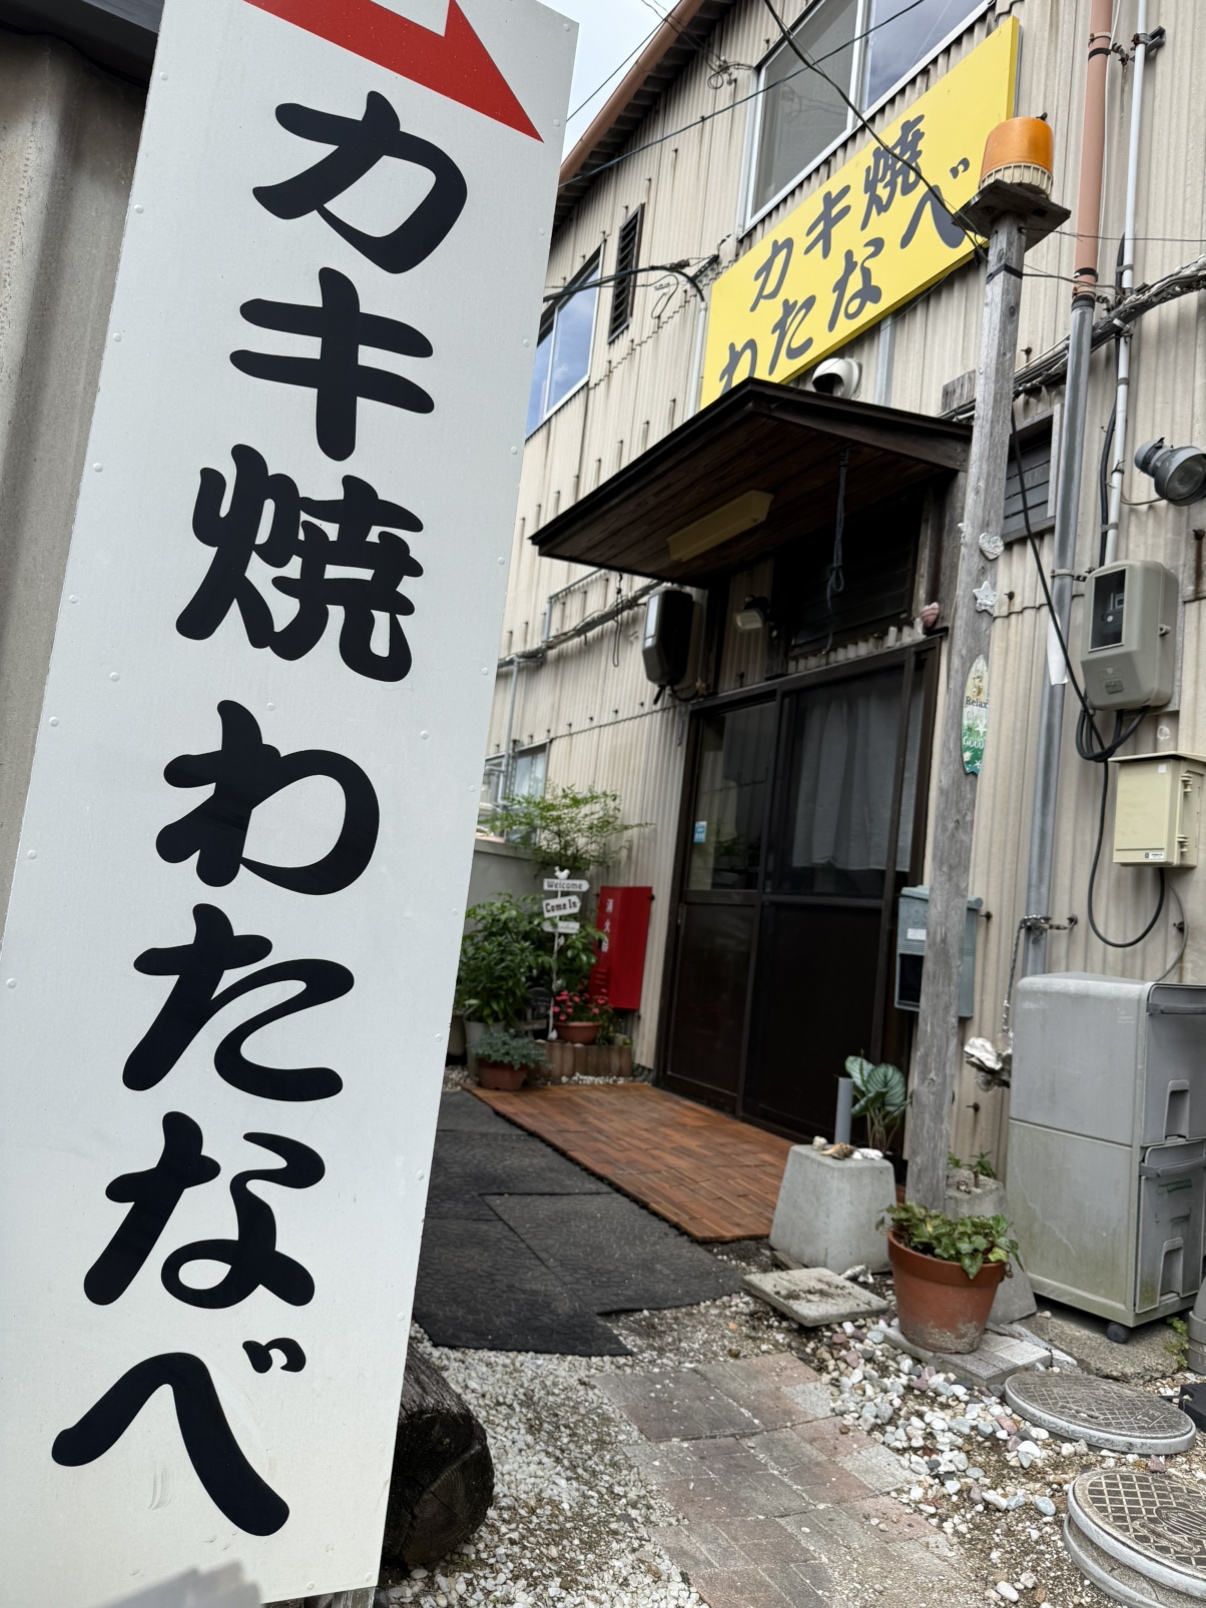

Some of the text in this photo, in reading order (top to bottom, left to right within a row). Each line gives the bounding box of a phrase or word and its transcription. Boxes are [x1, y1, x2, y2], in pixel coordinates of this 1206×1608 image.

[749, 113, 926, 313] カキ焼
[965, 696, 988, 708] Relax
[546, 880, 583, 890] Welcome
[545, 898, 578, 913] Come In
